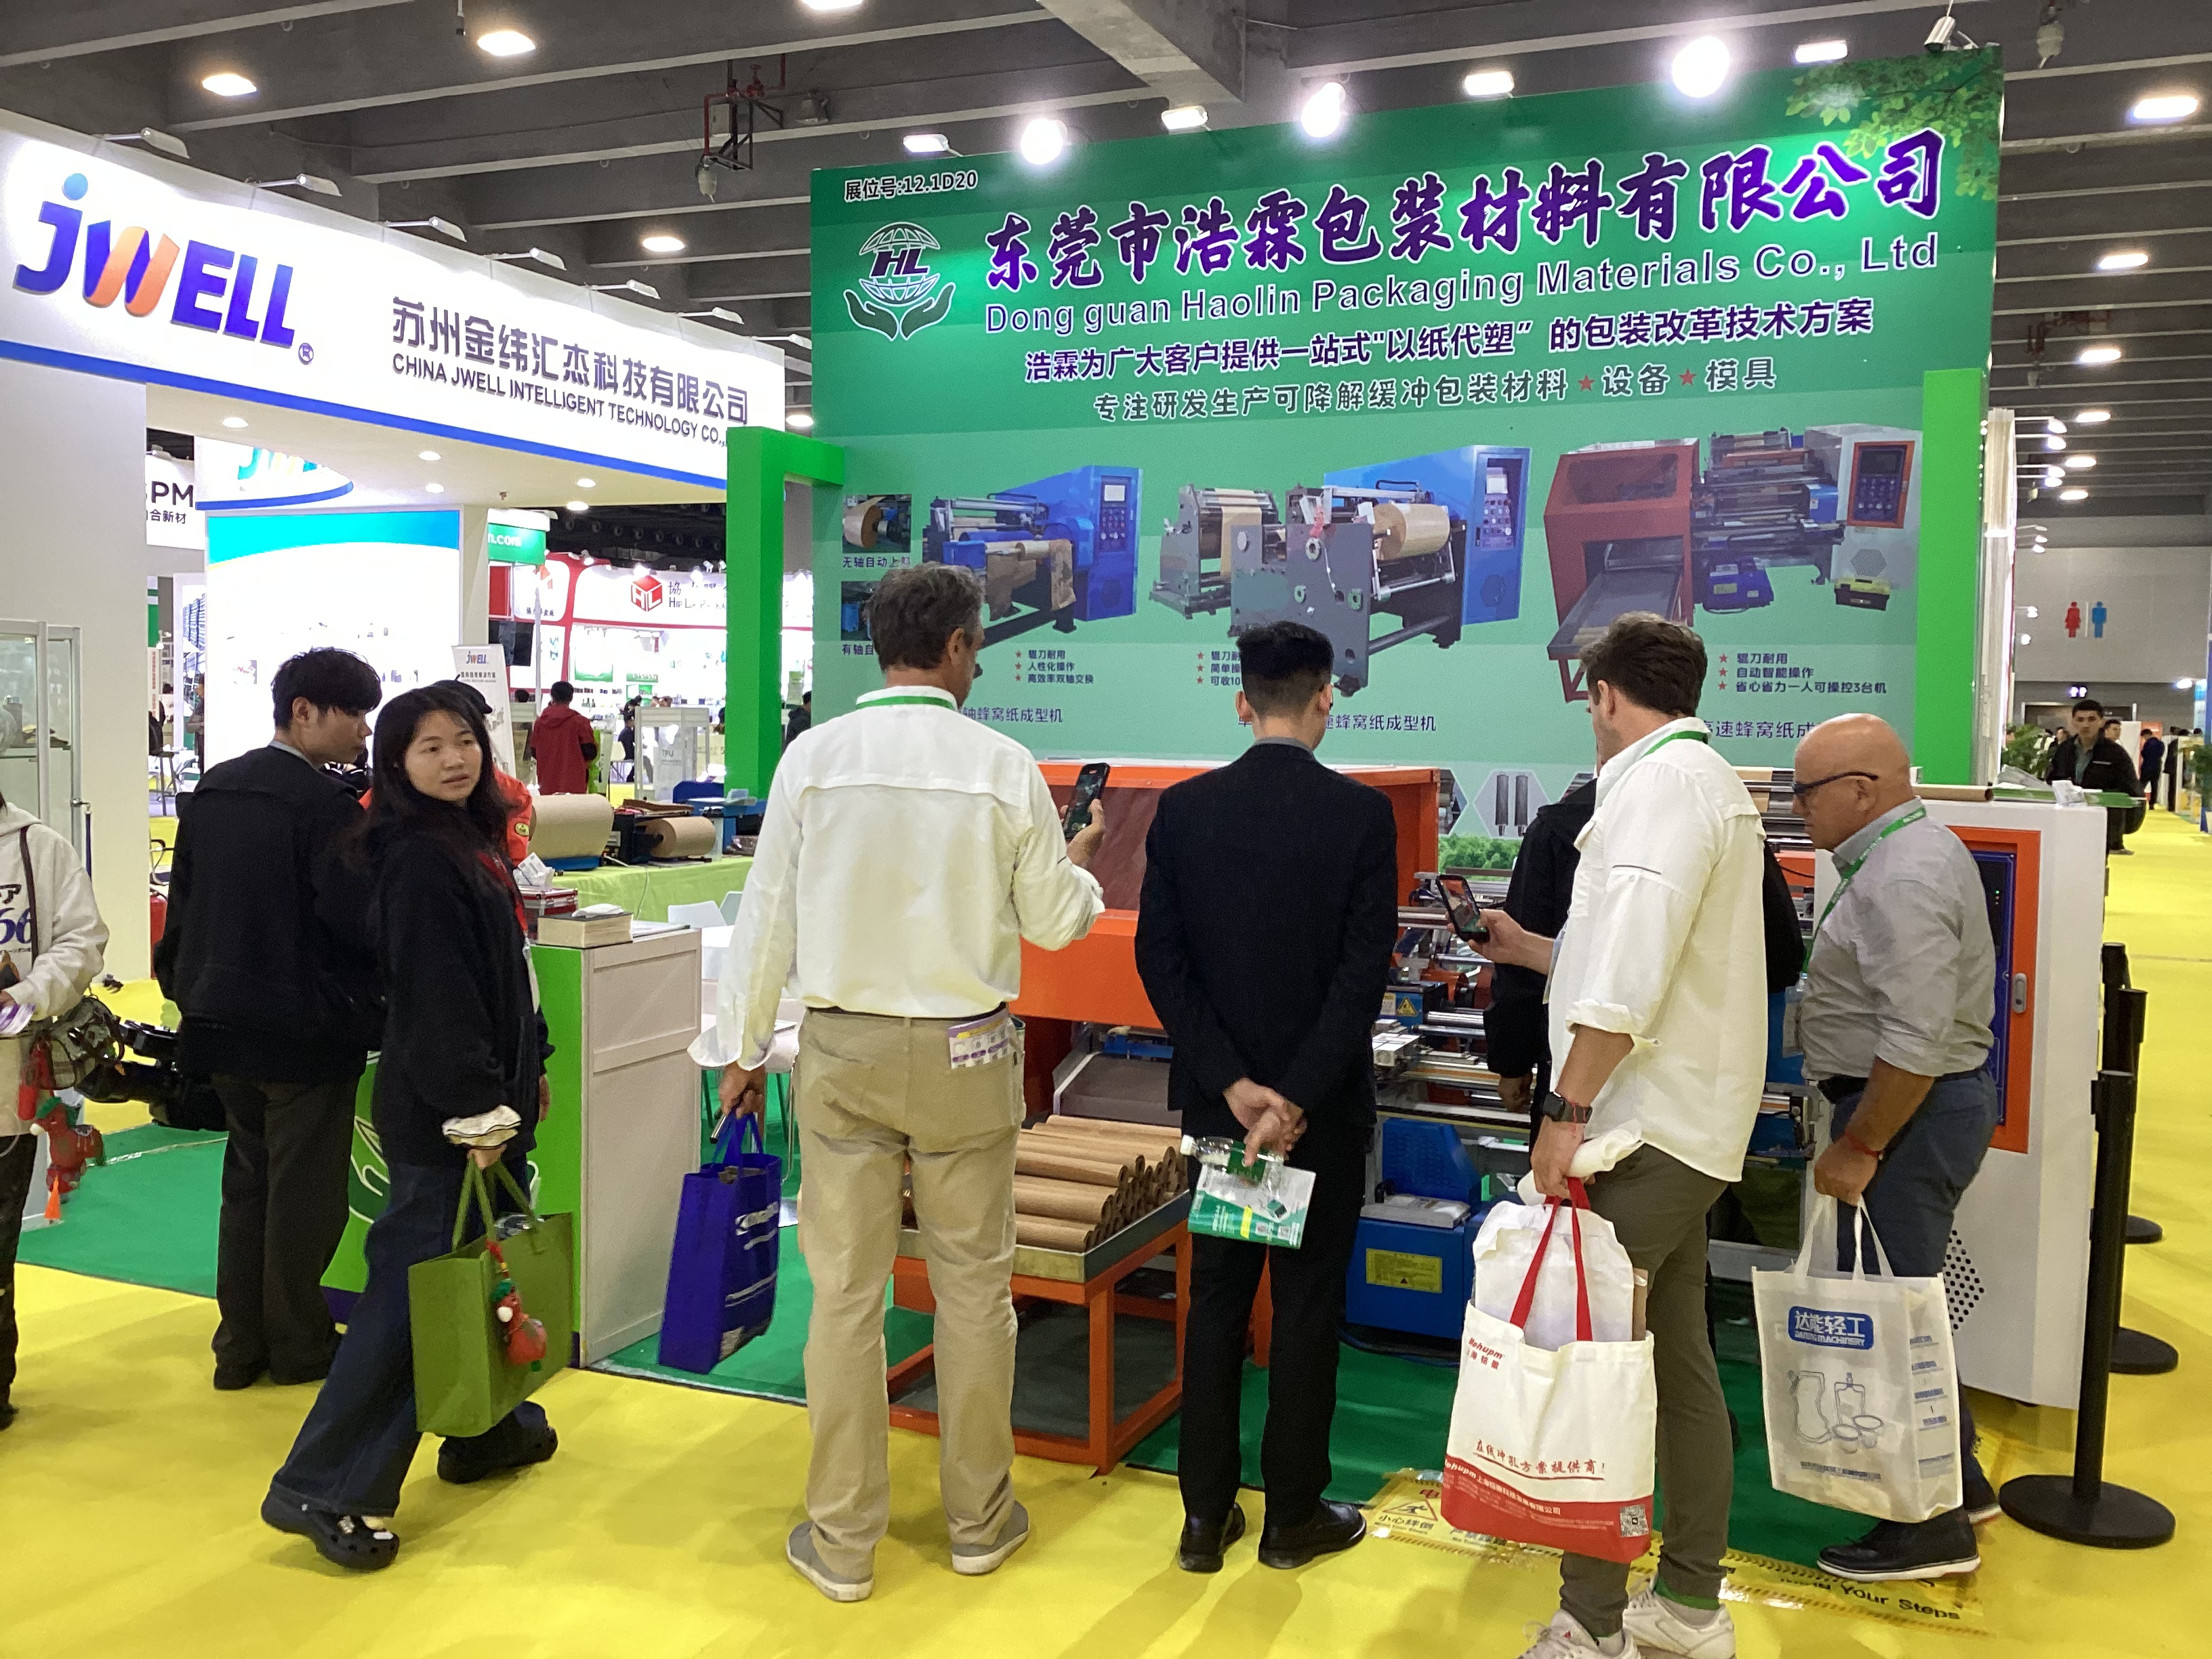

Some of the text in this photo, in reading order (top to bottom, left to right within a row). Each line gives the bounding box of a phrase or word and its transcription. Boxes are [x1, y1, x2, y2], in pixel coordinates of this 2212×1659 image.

[844, 171, 977, 201] 展位号:12.1D20
[985, 127, 1946, 292] 东莞市浩霖包装材料有限公司
[869, 248, 930, 276] HL
[985, 233, 1938, 335] Dong guan Haolin Packaging Materials Co., Ltd
[392, 296, 747, 425] 苏州金纬汇杰科技有限公司
[392, 353, 447, 384] CHINA
[451, 367, 506, 397] JWELL
[509, 379, 605, 418] INTELLIGENT
[607, 402, 699, 439] TECHNOLOGY
[1094, 356, 1778, 423] 专注研发生产可降解缓冲包装材料 设备 模具
[145, 480, 194, 508] PM
[146, 509, 186, 525] 合新材
[1736, 667, 1815, 678] 自动智能操作
[1839, 1582, 1889, 1605] Your
